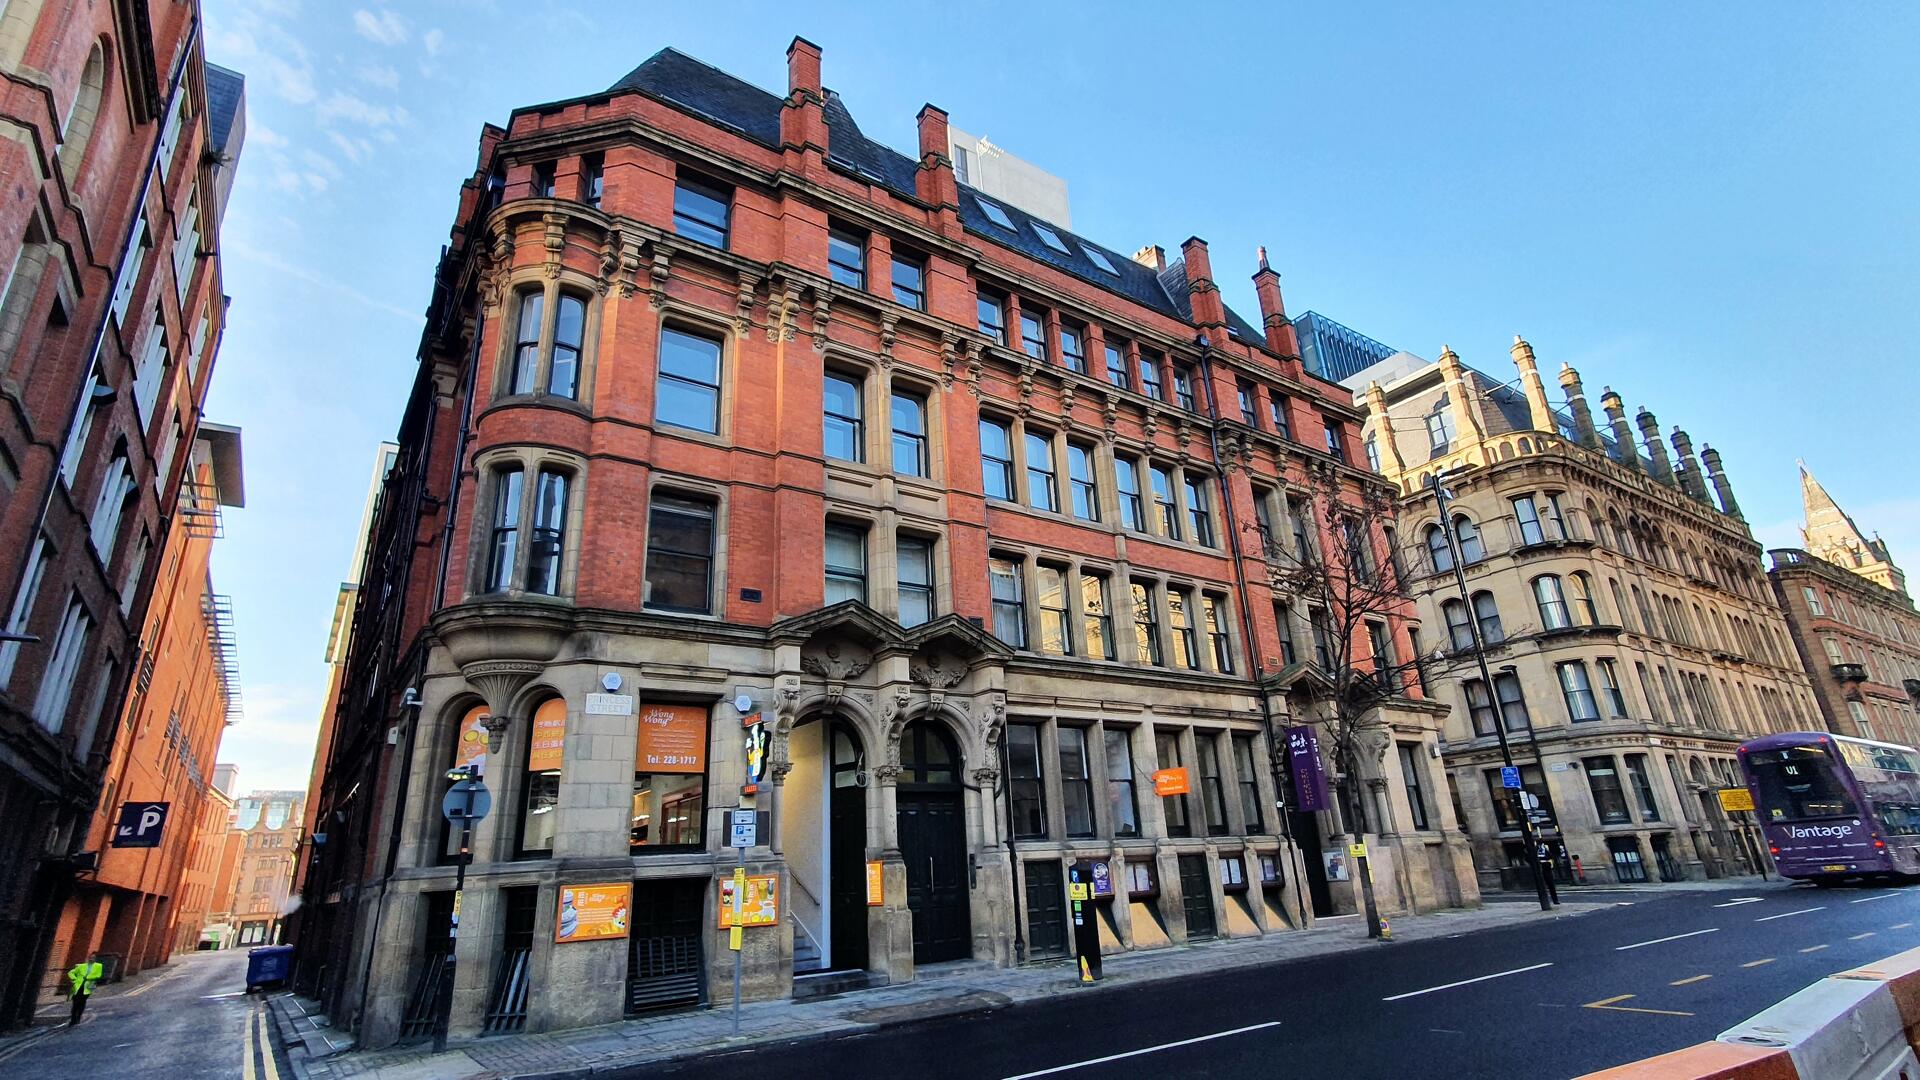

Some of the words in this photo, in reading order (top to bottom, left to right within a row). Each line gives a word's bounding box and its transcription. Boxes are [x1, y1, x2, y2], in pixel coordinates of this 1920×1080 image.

[588, 695, 631, 704] PRINCESS
[590, 704, 624, 712] STREET
[649, 708, 674, 721] Wong
[643, 714, 669, 727] Wong
[647, 755, 661, 764] Tel:
[663, 755, 697, 765] 228-1717
[1786, 766, 1798, 775] U1
[137, 811, 161, 836] P
[737, 826, 743, 834] P
[1783, 825, 1853, 839] Vantage
[1071, 870, 1078, 882] P
